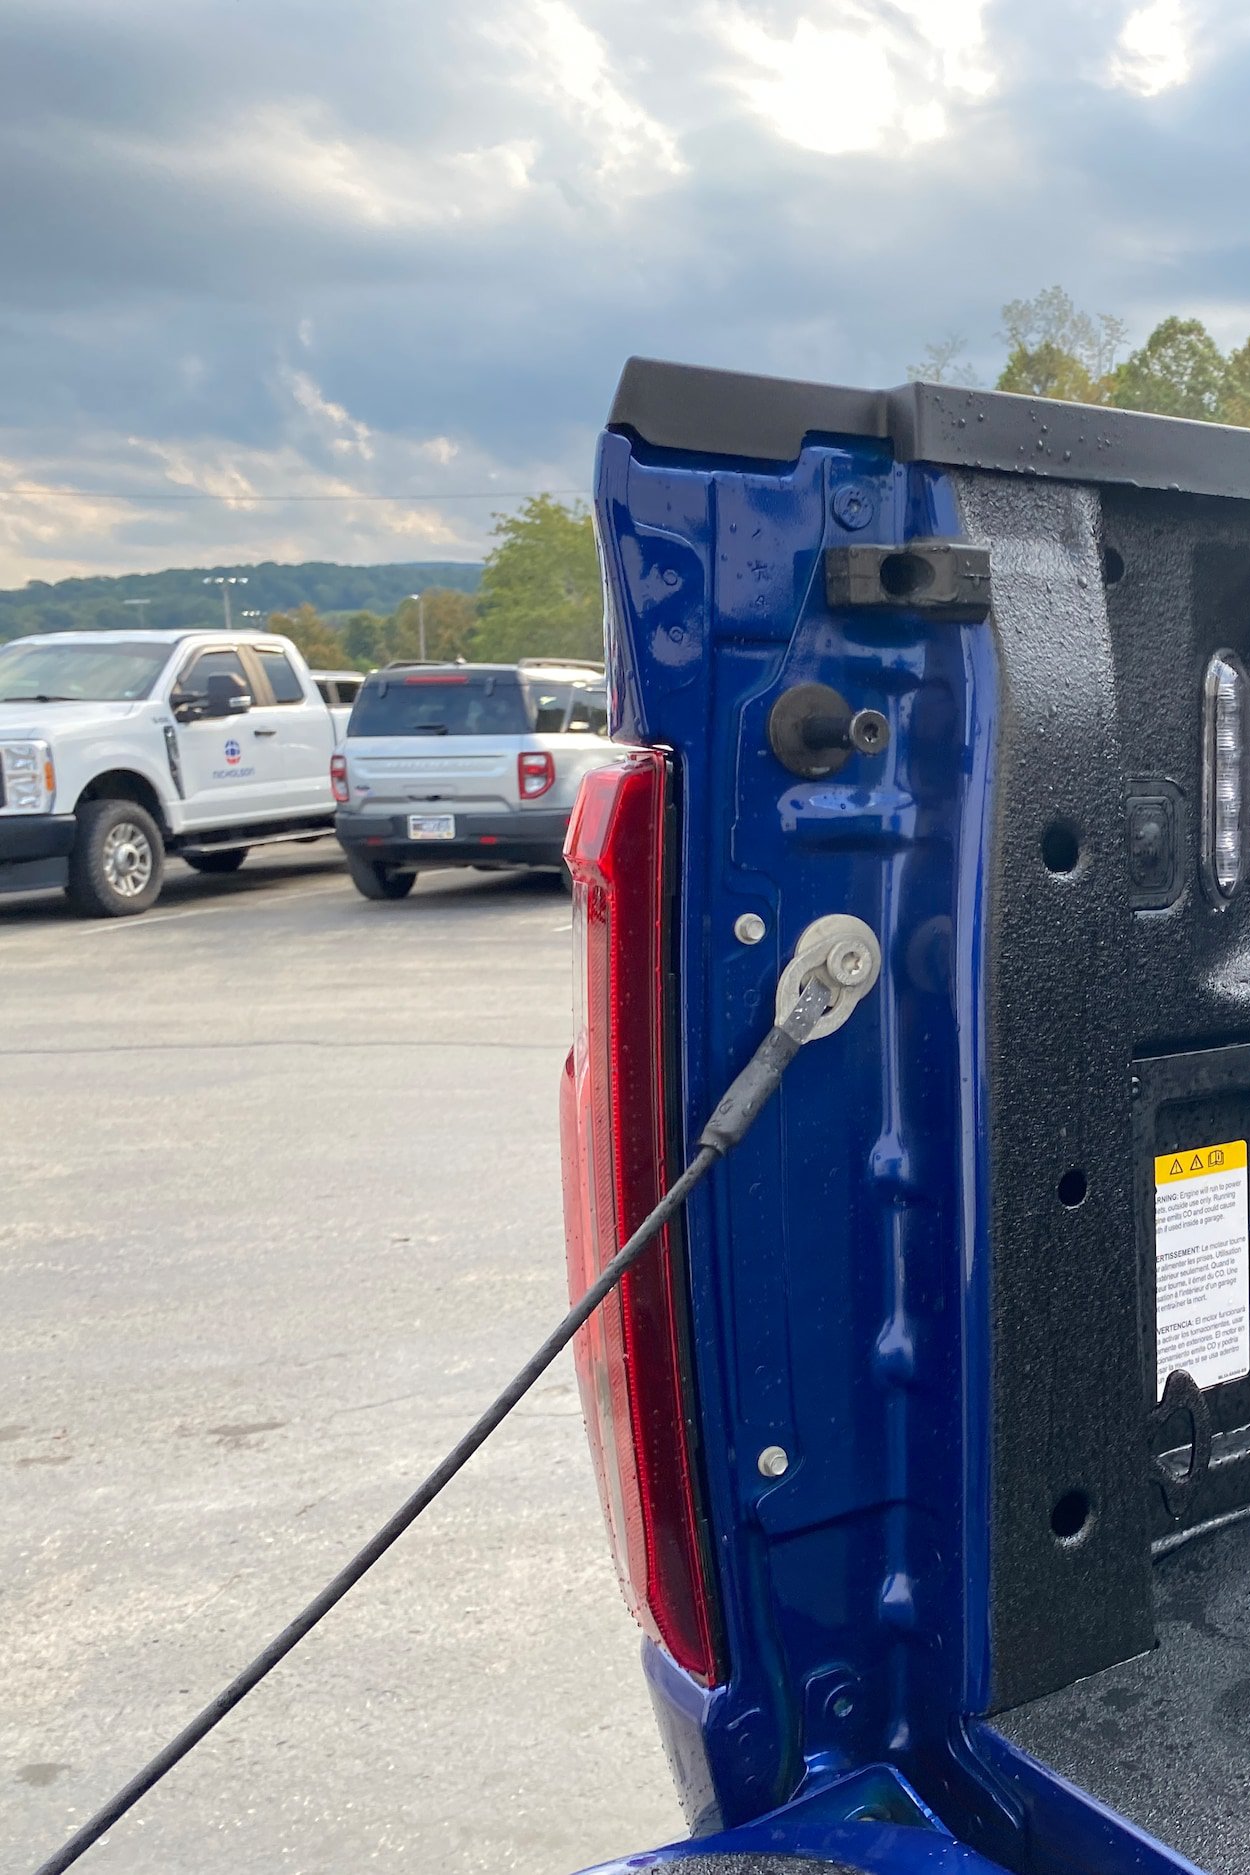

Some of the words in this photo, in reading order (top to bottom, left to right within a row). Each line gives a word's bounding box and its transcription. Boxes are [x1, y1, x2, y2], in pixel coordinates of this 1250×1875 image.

[1157, 1193, 1179, 1204] RNING:
[1180, 1190, 1199, 1199] Engine
[1200, 1186, 1208, 1194] will
[1225, 1180, 1241, 1190] power
[1168, 1202, 1188, 1212] outside
[1214, 1192, 1235, 1201] Running
[1167, 1214, 1182, 1222] emits
[1183, 1210, 1192, 1218] CO
[1204, 1205, 1219, 1214] could
[1220, 1202, 1235, 1210] cause
[1168, 1223, 1181, 1231] used
[1183, 1219, 1198, 1228] inside
[1210, 1240, 1228, 1249] moteur
[1229, 1236, 1246, 1245] tourne
[1161, 1260, 1186, 1272] alimenter
[1216, 1247, 1241, 1258] Utilisation
[1211, 1259, 1229, 1269] Quand
[1227, 1267, 1238, 1275] Une
[1218, 1278, 1236, 1288] garage
[1195, 1317, 1200, 1325] El
[1202, 1314, 1217, 1323] motor
[1162, 1333, 1180, 1344] activar
[1232, 1316, 1244, 1324] usar
[1222, 1327, 1236, 1336] motor
[1207, 1342, 1216, 1350] CO
[1220, 1346, 1239, 1356] adentro
